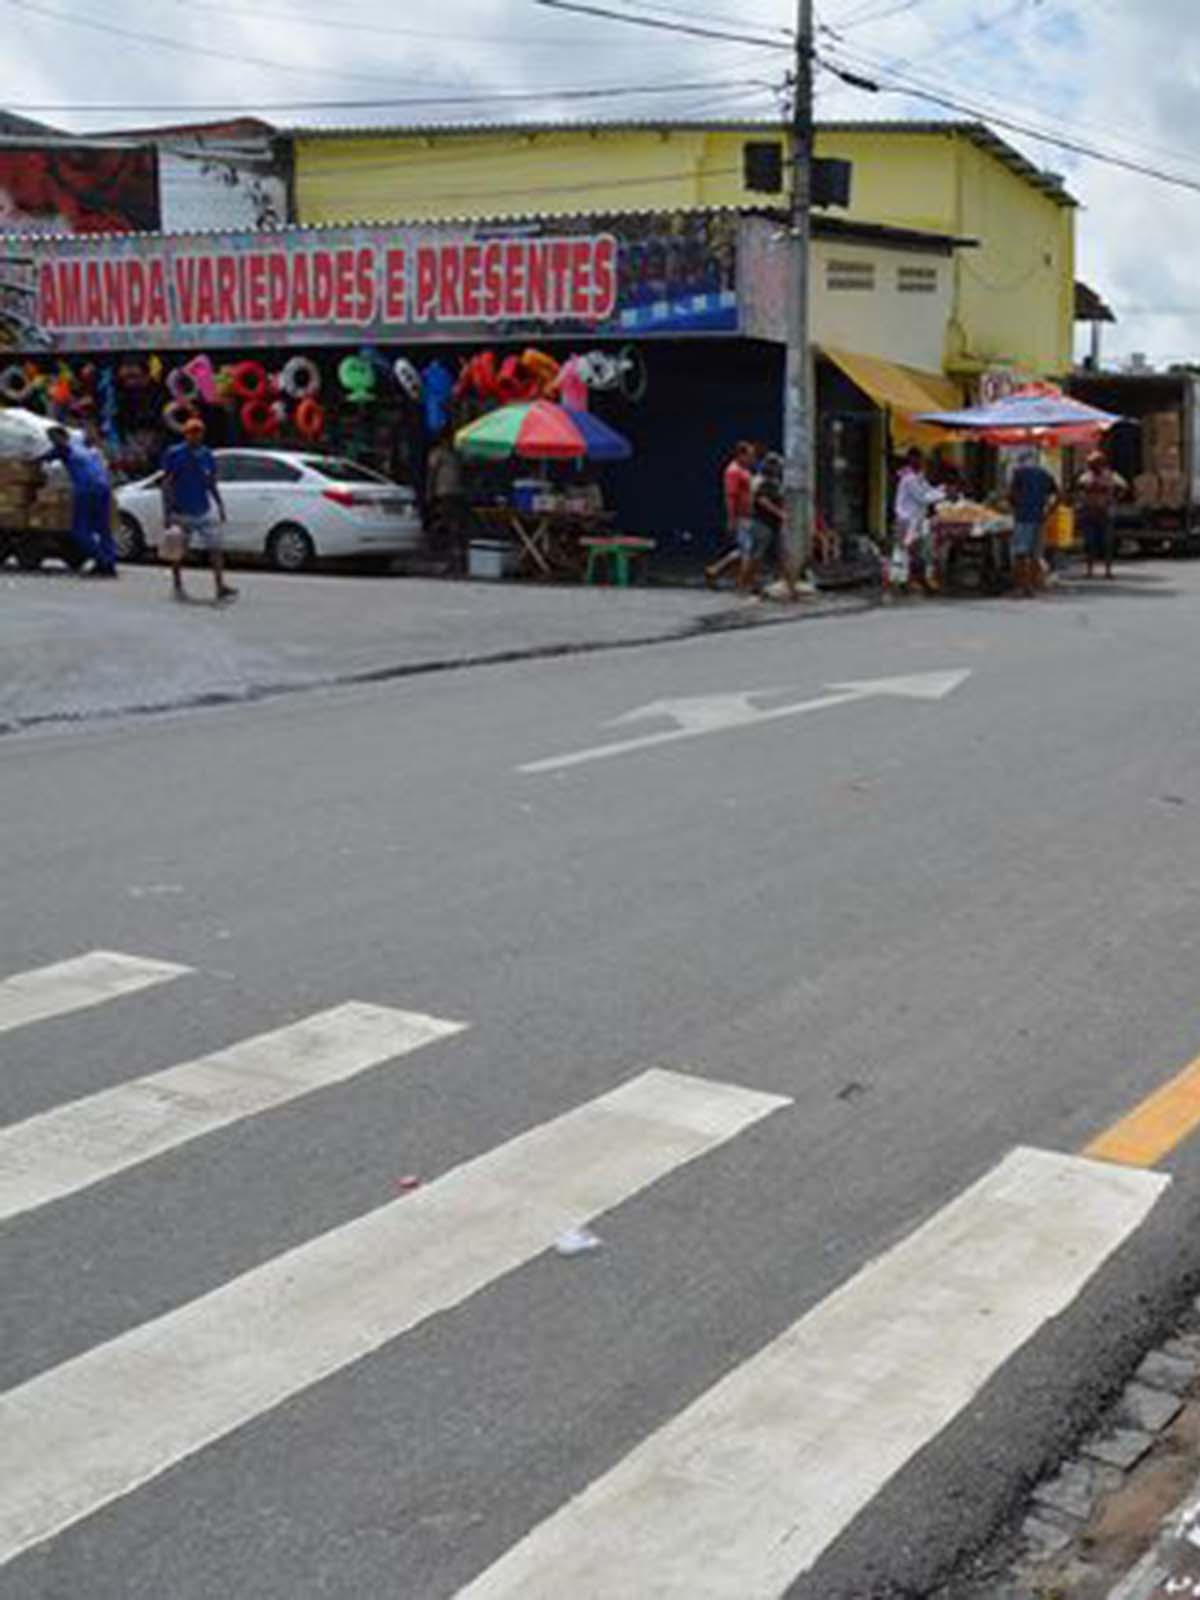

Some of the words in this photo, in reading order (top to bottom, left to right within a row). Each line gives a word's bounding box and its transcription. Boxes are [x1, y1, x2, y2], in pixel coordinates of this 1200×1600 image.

[38, 256, 169, 328] AMANDA
[174, 247, 375, 326] VARIEDADES
[385, 246, 405, 318] E
[415, 236, 614, 319] PRESENTES
